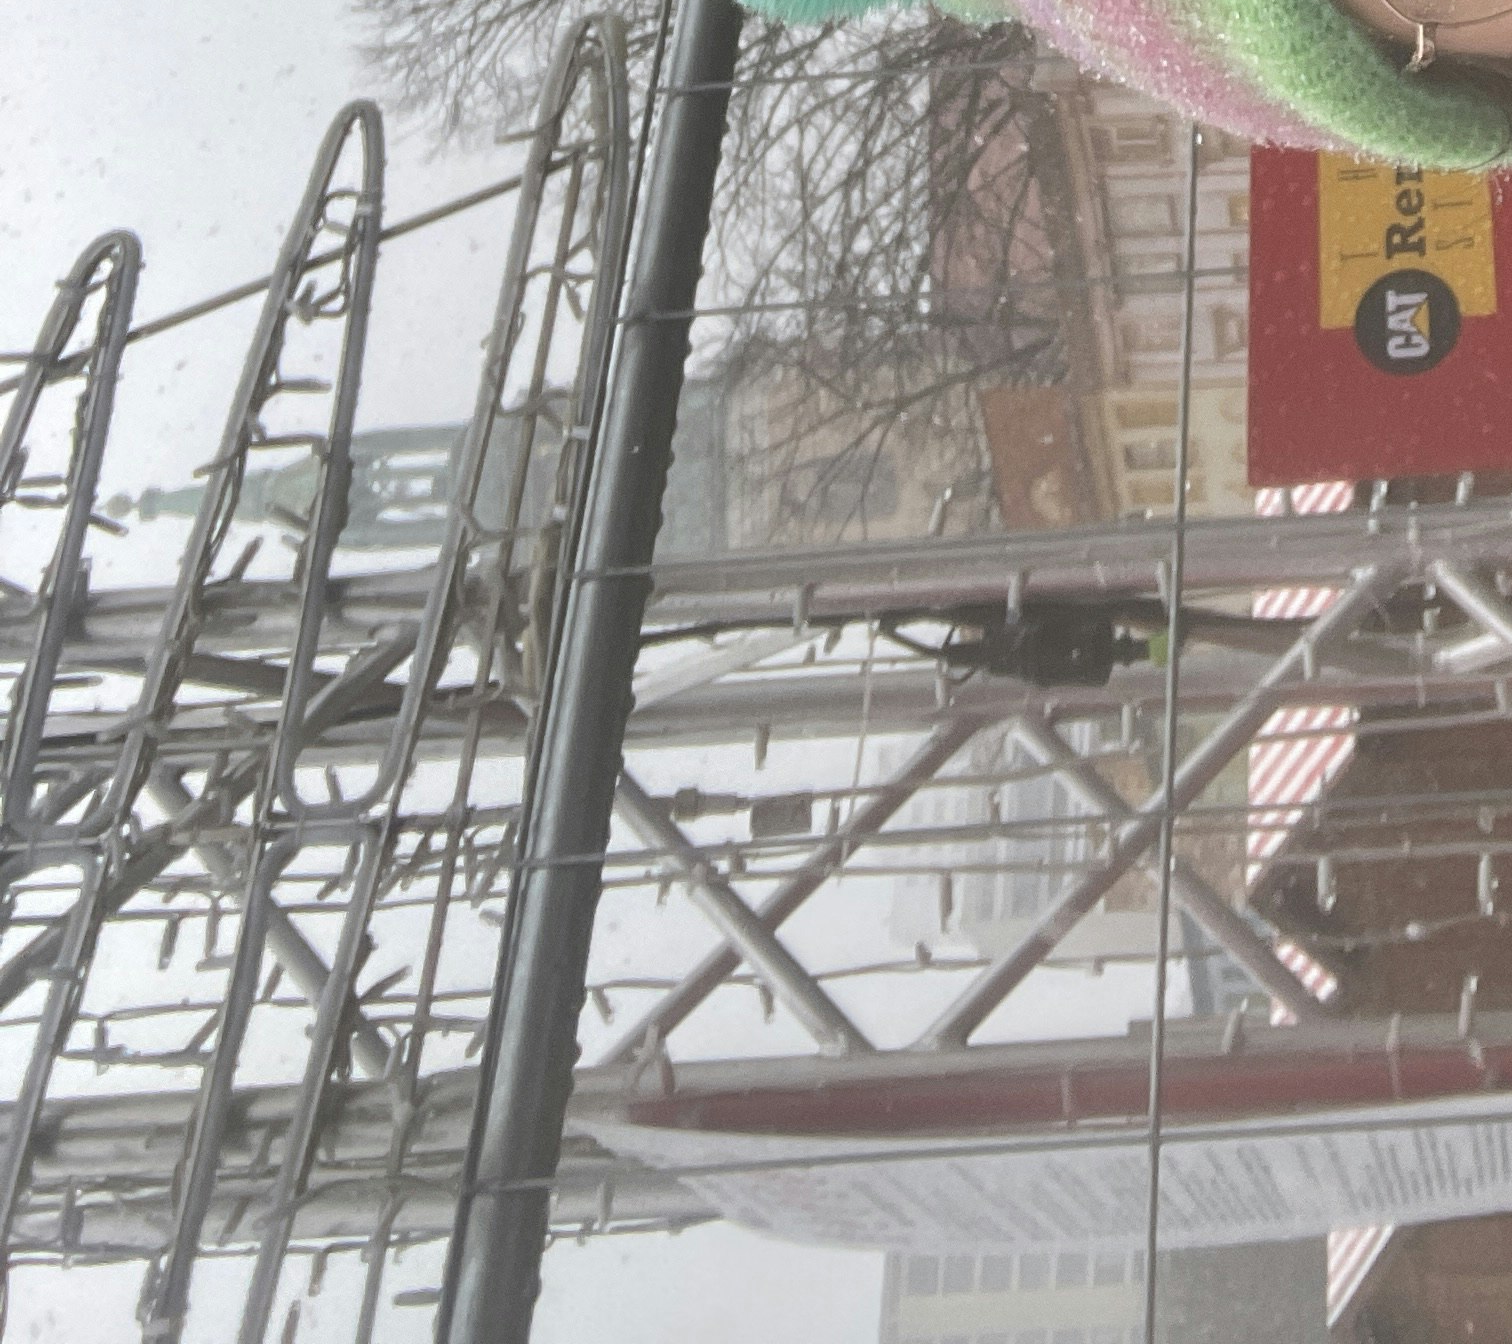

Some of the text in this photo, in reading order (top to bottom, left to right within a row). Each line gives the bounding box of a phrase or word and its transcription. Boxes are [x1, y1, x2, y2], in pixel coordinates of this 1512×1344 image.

[1337, 168, 1378, 263] TH
[1384, 162, 1427, 260] Ren
[1385, 290, 1431, 359] CAT
